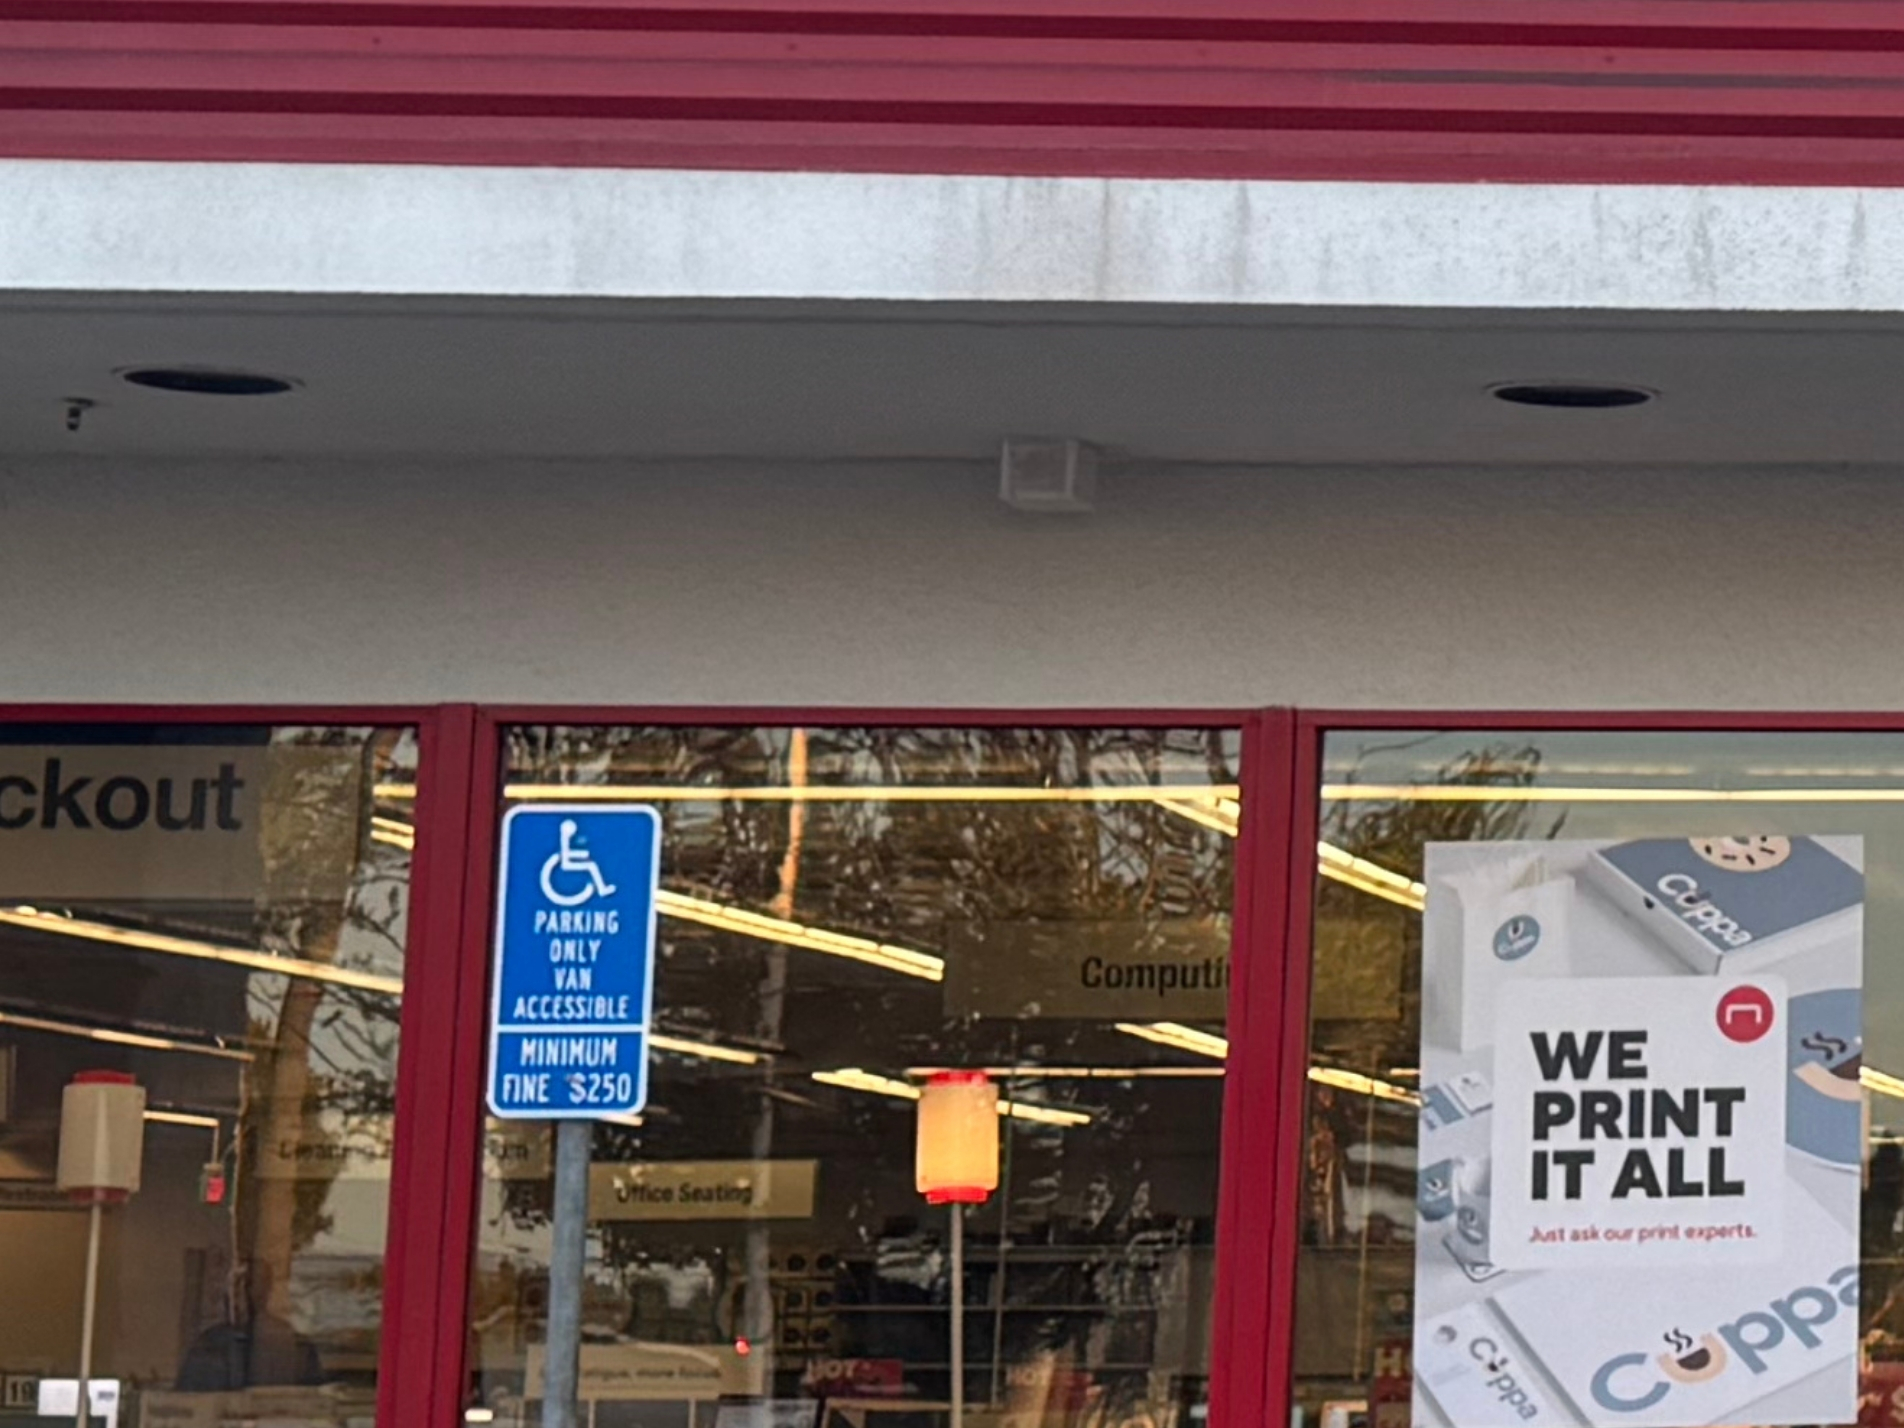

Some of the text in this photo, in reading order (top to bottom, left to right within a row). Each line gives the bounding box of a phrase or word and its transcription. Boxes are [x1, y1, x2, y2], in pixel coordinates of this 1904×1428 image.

[533, 909, 620, 935] PARKING
[549, 938, 601, 963] ONLY
[554, 967, 593, 991] VAN
[1081, 956, 1230, 997] Computi
[513, 995, 630, 1020] ACCESSIBLE
[519, 1037, 618, 1067] MINIMUM
[1529, 1030, 1648, 1081] WE
[502, 1073, 632, 1104] FINE $250
[1533, 1087, 1746, 1140] PRINT
[1532, 1147, 1746, 1200] IT ALL
[616, 1180, 753, 1209] Office Seating
[1529, 1225, 1566, 1244] Just
[1570, 1225, 1599, 1242] ask
[1603, 1228, 1634, 1241] our
[1638, 1224, 1681, 1245] print
